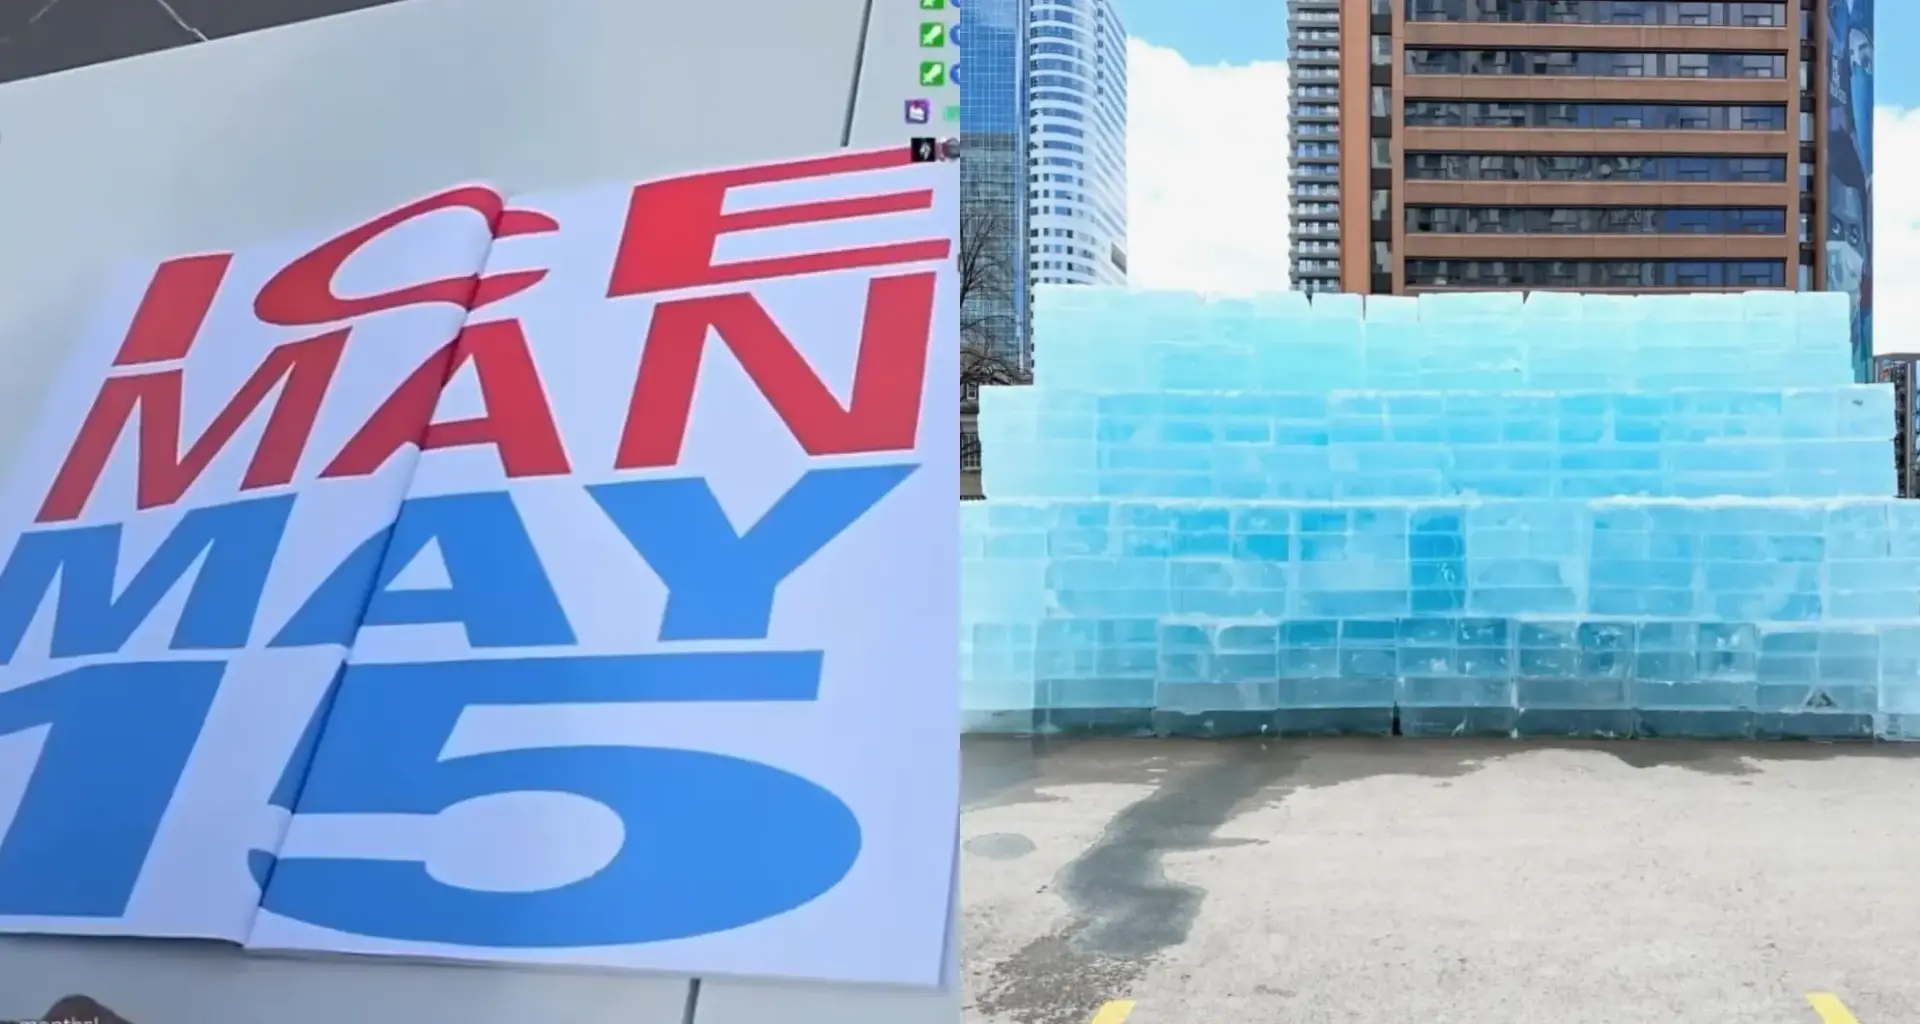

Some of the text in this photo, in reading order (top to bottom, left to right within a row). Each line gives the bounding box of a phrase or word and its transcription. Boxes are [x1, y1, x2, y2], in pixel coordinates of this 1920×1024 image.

[112, 146, 950, 365] ICE
[34, 271, 936, 523] MAN
[0, 463, 922, 666] MAY
[0, 650, 862, 948] 15
